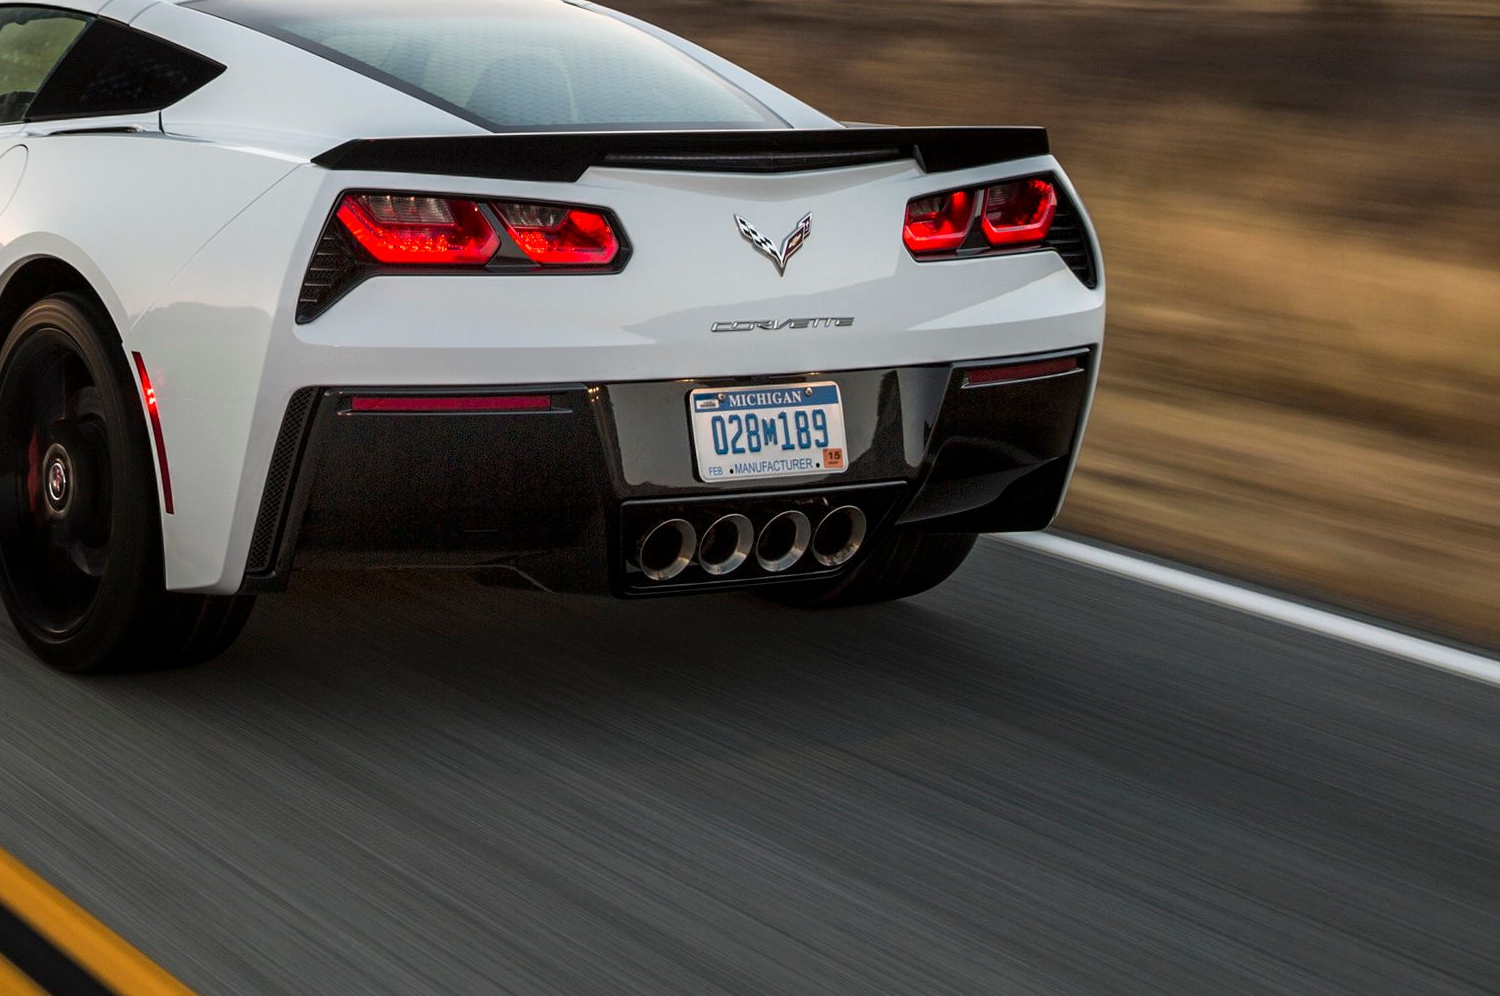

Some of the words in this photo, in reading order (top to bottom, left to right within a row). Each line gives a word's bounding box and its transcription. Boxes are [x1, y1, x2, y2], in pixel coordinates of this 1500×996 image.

[711, 316, 855, 332] CORVETTE
[728, 390, 802, 407] MICHIGAN
[711, 409, 829, 455] 028M189
[828, 451, 841, 460] 15
[708, 466, 723, 476] FEB
[734, 458, 813, 474] MANUFACTURER
